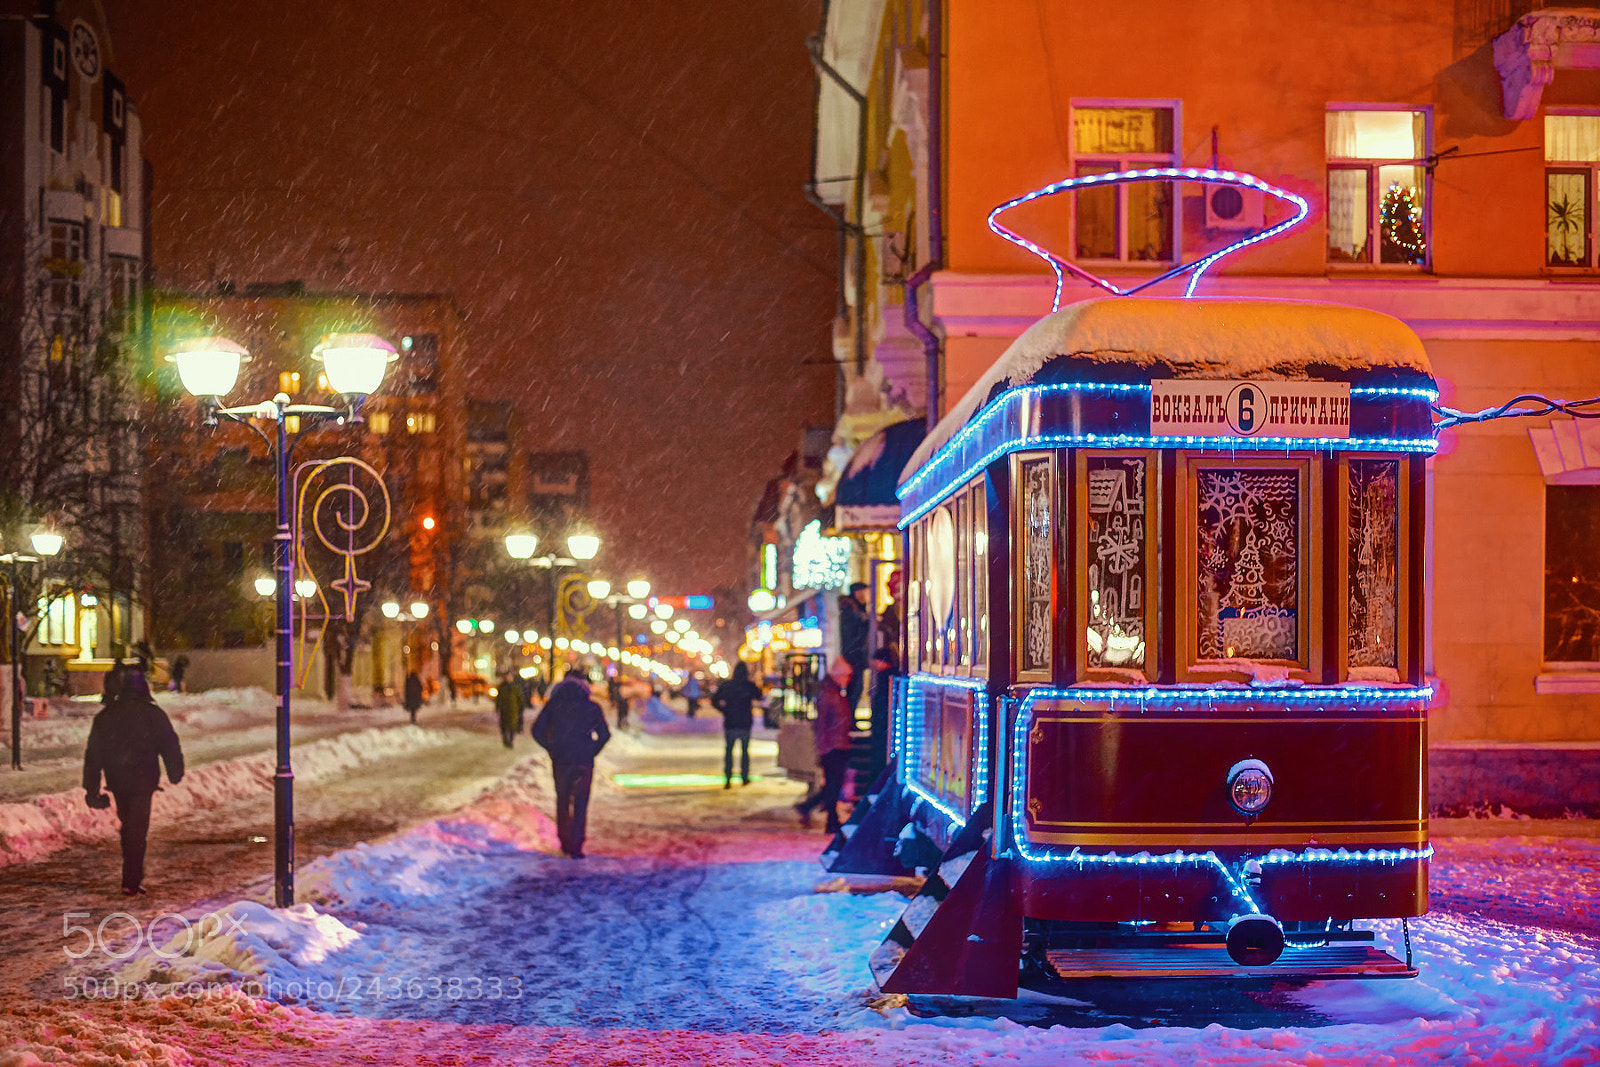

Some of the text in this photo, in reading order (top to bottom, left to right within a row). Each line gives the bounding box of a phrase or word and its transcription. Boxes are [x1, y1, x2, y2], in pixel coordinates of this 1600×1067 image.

[1152, 387, 1350, 432] ВОКЗАЛЪ 6 ПРИСТАНИ
